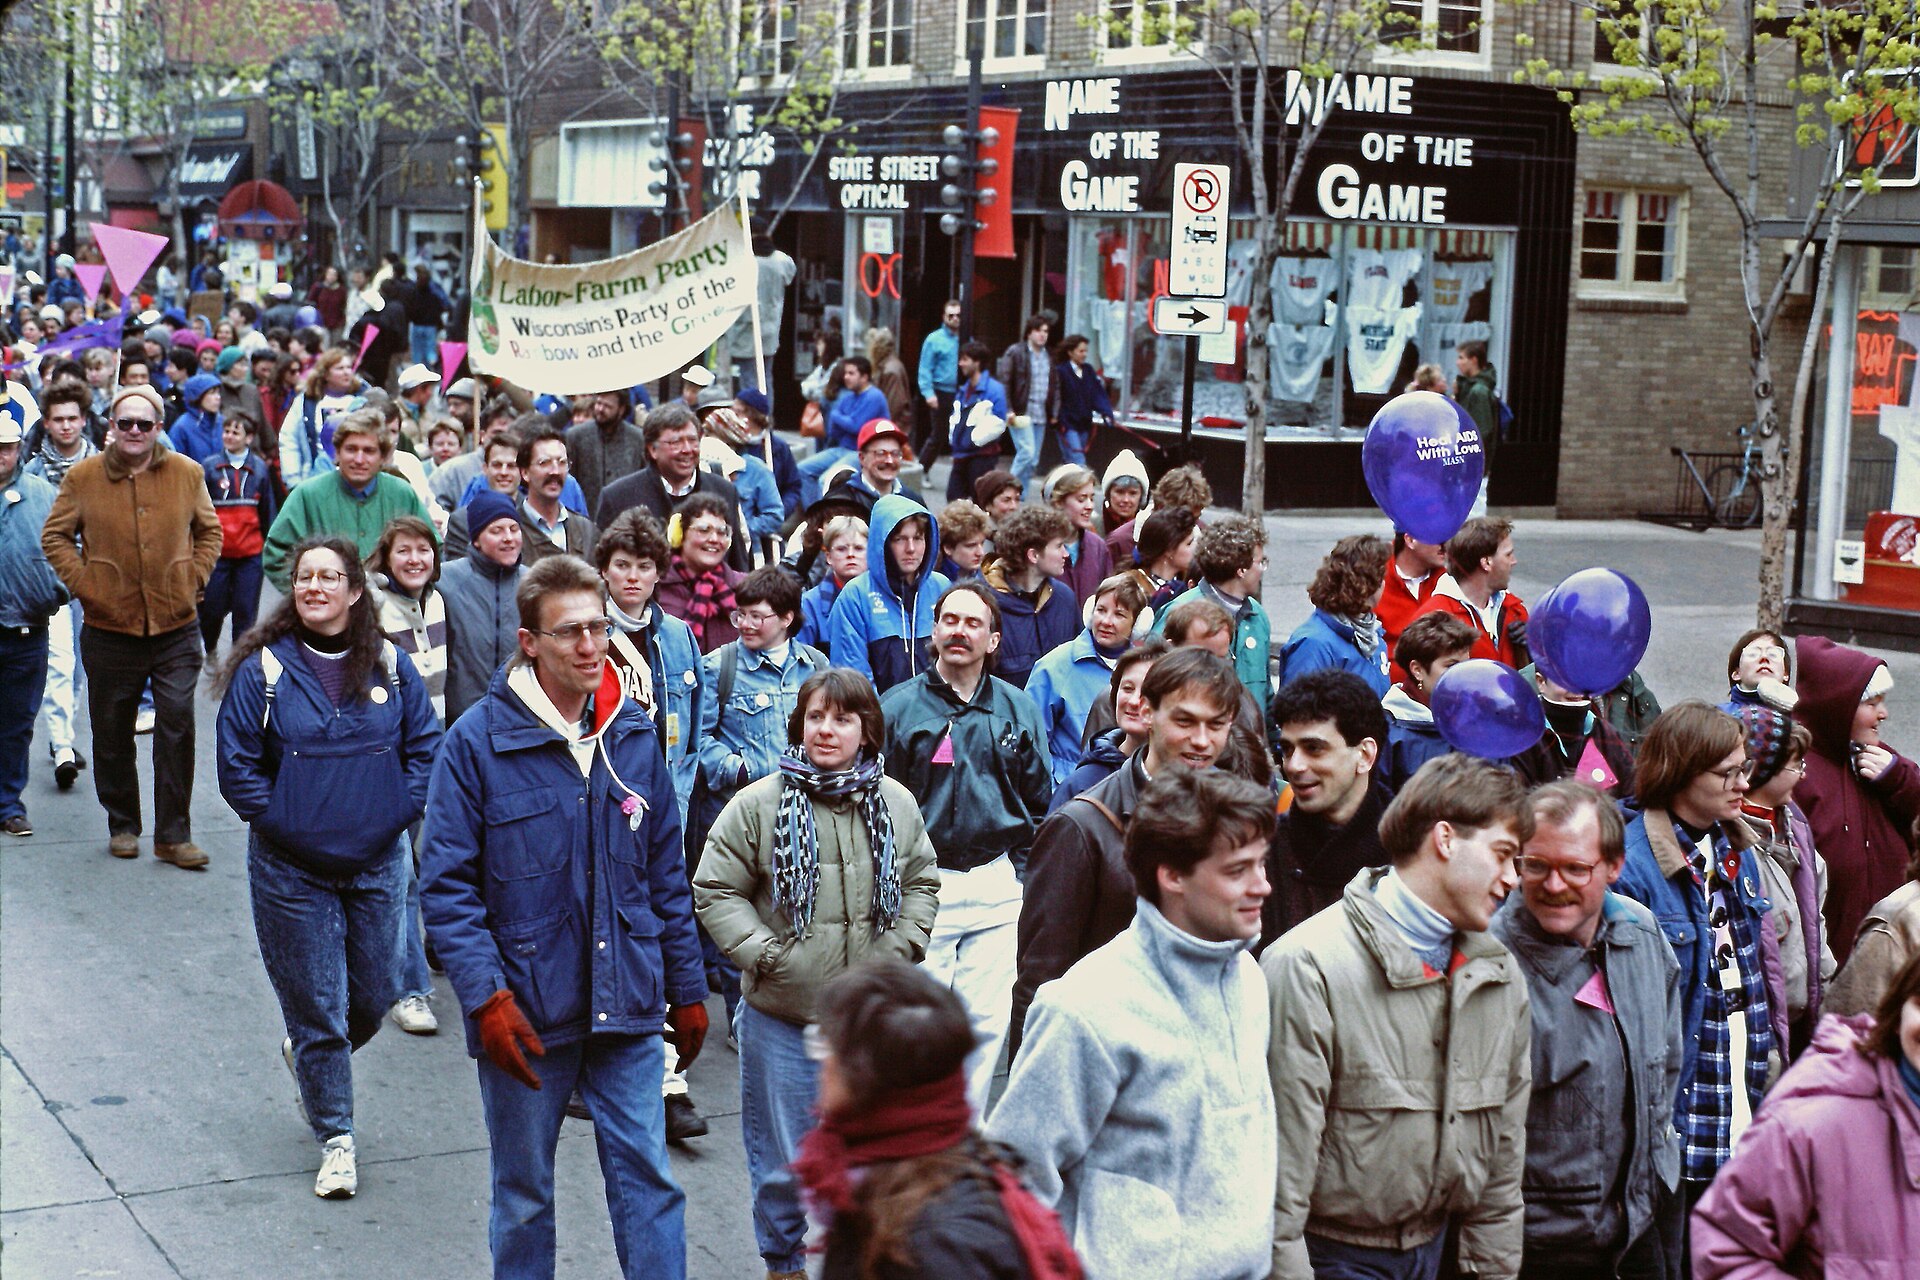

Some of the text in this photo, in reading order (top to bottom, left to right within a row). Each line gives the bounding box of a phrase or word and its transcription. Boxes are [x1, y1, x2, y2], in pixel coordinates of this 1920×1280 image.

[1044, 78, 1121, 131] NAME
[1285, 70, 1414, 126] NAME
[1090, 131, 1160, 160] OF THE
[1361, 132, 1473, 167] OF THE
[829, 156, 940, 181] STATE STREET
[1060, 160, 1139, 212] GAME
[841, 184, 909, 209] OPTICAL
[1317, 163, 1447, 224] GAME
[500, 239, 728, 307] Labor-Farm Party
[511, 275, 736, 338] Wisconsin's Party of the
[509, 340, 579, 362] Rabow
[587, 337, 624, 358] and
[630, 327, 664, 350] the
[1416, 430, 1478, 448] Heal AIDS
[1416, 446, 1451, 460] With
